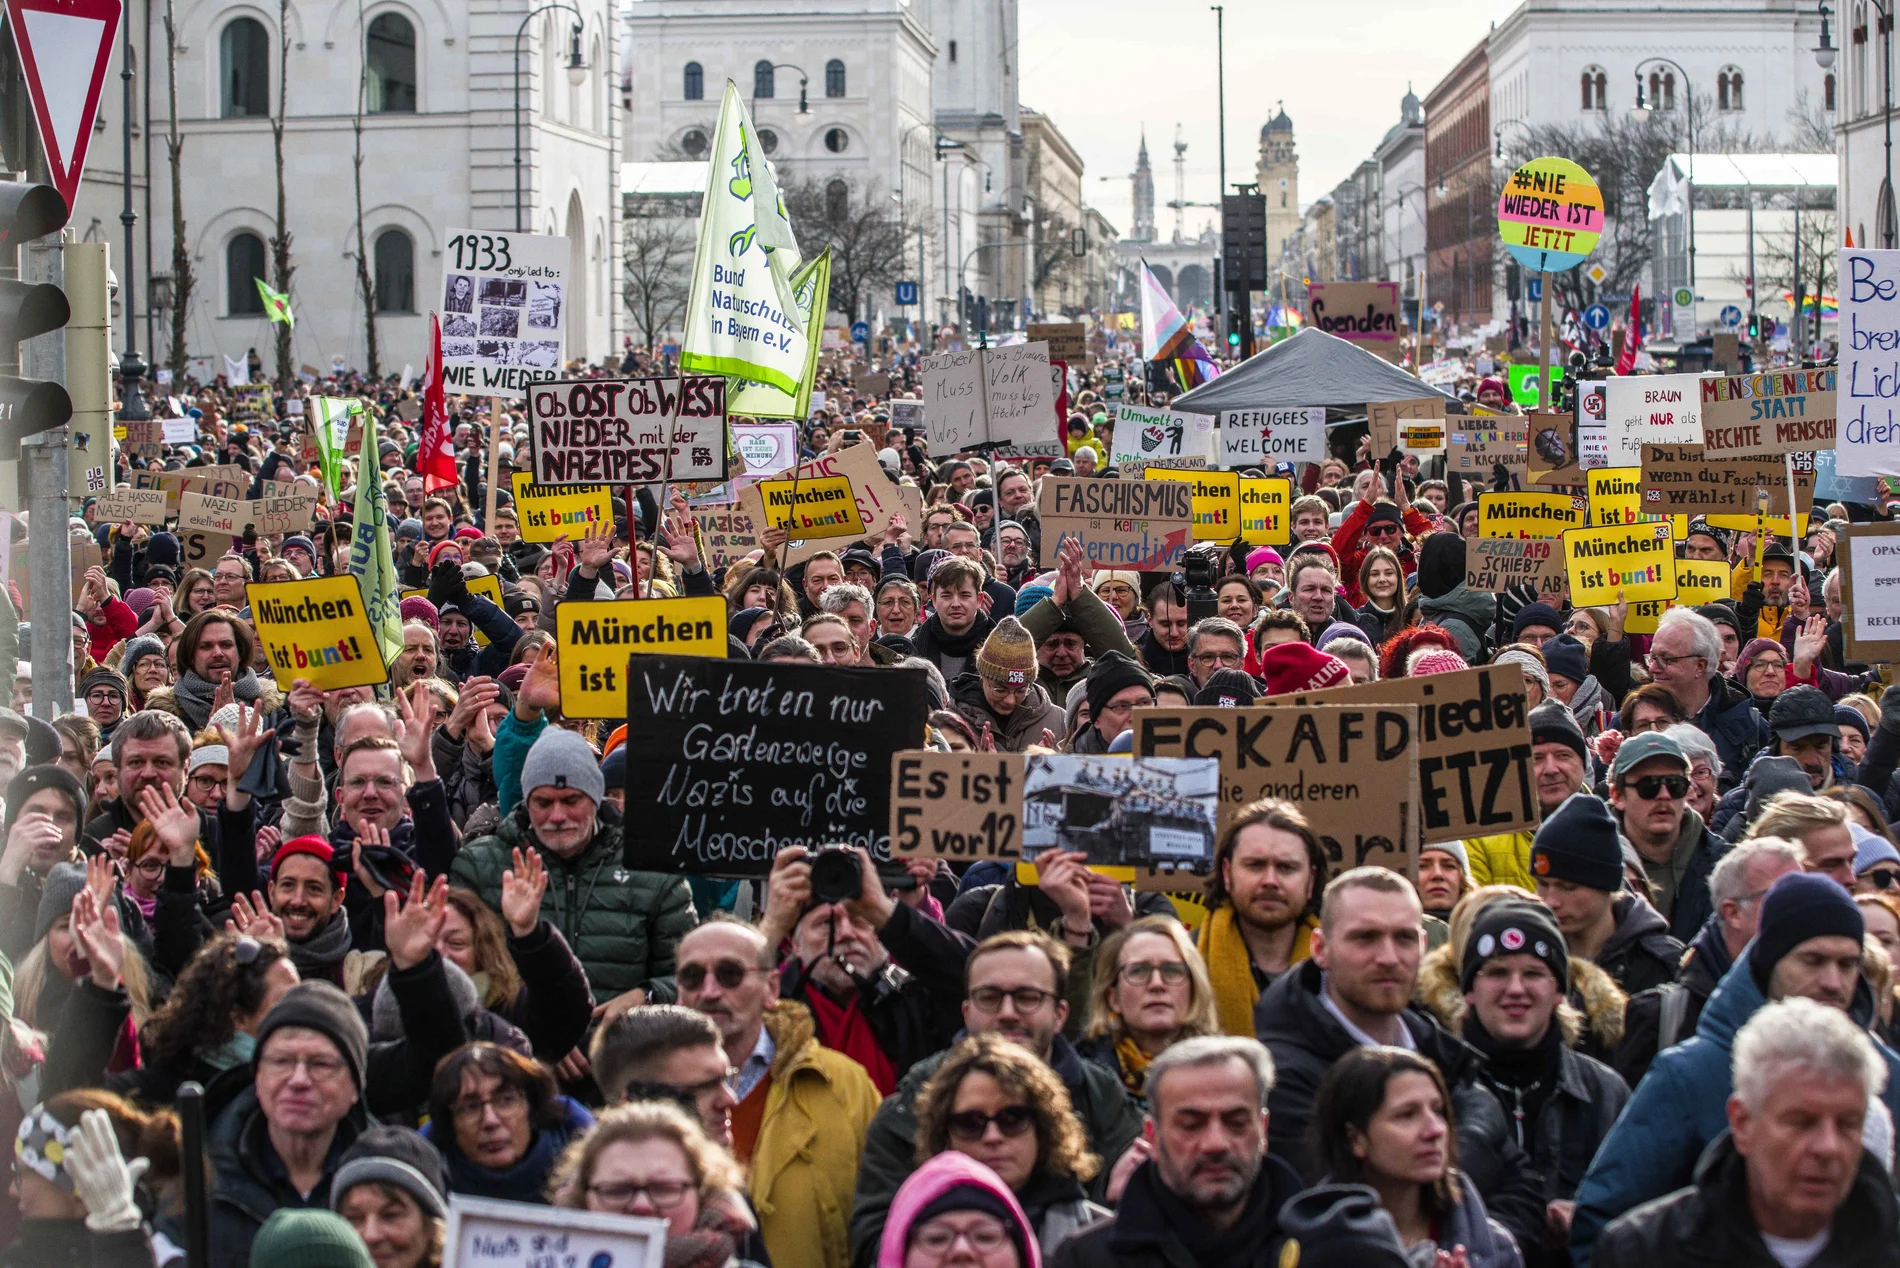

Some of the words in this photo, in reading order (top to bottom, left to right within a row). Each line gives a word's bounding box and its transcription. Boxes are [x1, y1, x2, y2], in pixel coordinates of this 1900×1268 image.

[1513, 169, 1566, 195] #NIE
[1504, 193, 1560, 220] WIEDER
[1567, 202, 1596, 226] IST
[1522, 226, 1576, 252] JETZT
[448, 234, 512, 271] 1933
[508, 268, 526, 278] only
[527, 265, 542, 277] led
[713, 264, 745, 288] Bund
[1848, 256, 1900, 302] Be
[900, 285, 913, 301] U
[1311, 298, 1397, 332] Spenden
[711, 315, 722, 334] in
[728, 318, 760, 343] Bayern
[763, 331, 792, 354] e.V.
[442, 366, 476, 388] NIE
[1702, 368, 1837, 403] MENSCHENRECH
[568, 384, 625, 418] OST
[654, 377, 724, 418] WEST
[1645, 390, 1682, 403] BRAUN
[1120, 407, 1172, 427] Umwelt
[1750, 396, 1806, 420] STATT
[1229, 411, 1309, 429] REFUGEES
[1458, 420, 1498, 430] LIEBER
[1624, 415, 1643, 432] geht
[1650, 412, 1674, 425] NUR
[1681, 411, 1697, 424] als
[540, 418, 635, 448] NIEDER
[640, 424, 666, 445] mit
[672, 424, 698, 443] der
[1146, 426, 1165, 441] AfD
[1704, 425, 1762, 450] RECHTE
[1022, 445, 1061, 457] KACKE
[1226, 438, 1308, 454] WELCOME
[1465, 443, 1486, 453] ALS
[1651, 447, 1675, 463] Du
[1679, 446, 1705, 462] bist
[542, 447, 680, 481] NAZIPEST
[1153, 458, 1206, 469] DEUTSCHLAND
[1648, 470, 1693, 484] wenn
[1698, 467, 1719, 484] du
[1722, 470, 1809, 487] Faschistn
[128, 490, 163, 504] HASSEN
[769, 487, 846, 506] München
[1192, 481, 1231, 498] chen
[1241, 488, 1282, 504] chen
[1665, 489, 1736, 505] Wählst
[201, 497, 238, 513] NAZIS
[266, 498, 308, 515] WIEDER
[1056, 483, 1190, 518] FASCHISMUS
[189, 515, 233, 531] ekelhafd
[260, 512, 291, 533] 1933
[527, 511, 547, 527] ist
[550, 505, 600, 526] bunt!
[801, 509, 850, 528] bunt!
[1242, 510, 1278, 530] unt!
[1487, 502, 1576, 523] München
[1600, 507, 1621, 525] ist
[1090, 519, 1101, 529] ist
[1113, 519, 1149, 534] keine
[710, 535, 728, 546] WIR
[1475, 541, 1551, 559] EKELHAFD
[1573, 536, 1664, 558] München
[1482, 556, 1545, 574] SCHIEBT
[1467, 571, 1498, 590] DEN
[1541, 576, 1562, 593] AB
[1580, 570, 1604, 589] ist
[1608, 564, 1662, 587] bunt!
[1677, 570, 1722, 589] chen
[258, 596, 355, 625] München
[571, 616, 713, 645] München
[1867, 616, 1900, 627] RECH
[270, 642, 292, 669] ist
[292, 636, 363, 669] bunt!
[579, 664, 616, 692] ist
[643, 669, 710, 715] Wir
[717, 672, 814, 717] treten
[830, 695, 885, 723] nur
[1218, 697, 1236, 705] FCK
[1421, 670, 1527, 743] ieder
[683, 723, 868, 780] Gartenzwerge
[898, 759, 949, 799] Es
[961, 760, 1012, 805] ist
[1258, 770, 1360, 802] anderen
[1421, 744, 1534, 830] ETZT
[657, 763, 754, 808] Nazis
[770, 772, 826, 827] auf
[825, 778, 867, 817] die
[897, 807, 921, 851] 5
